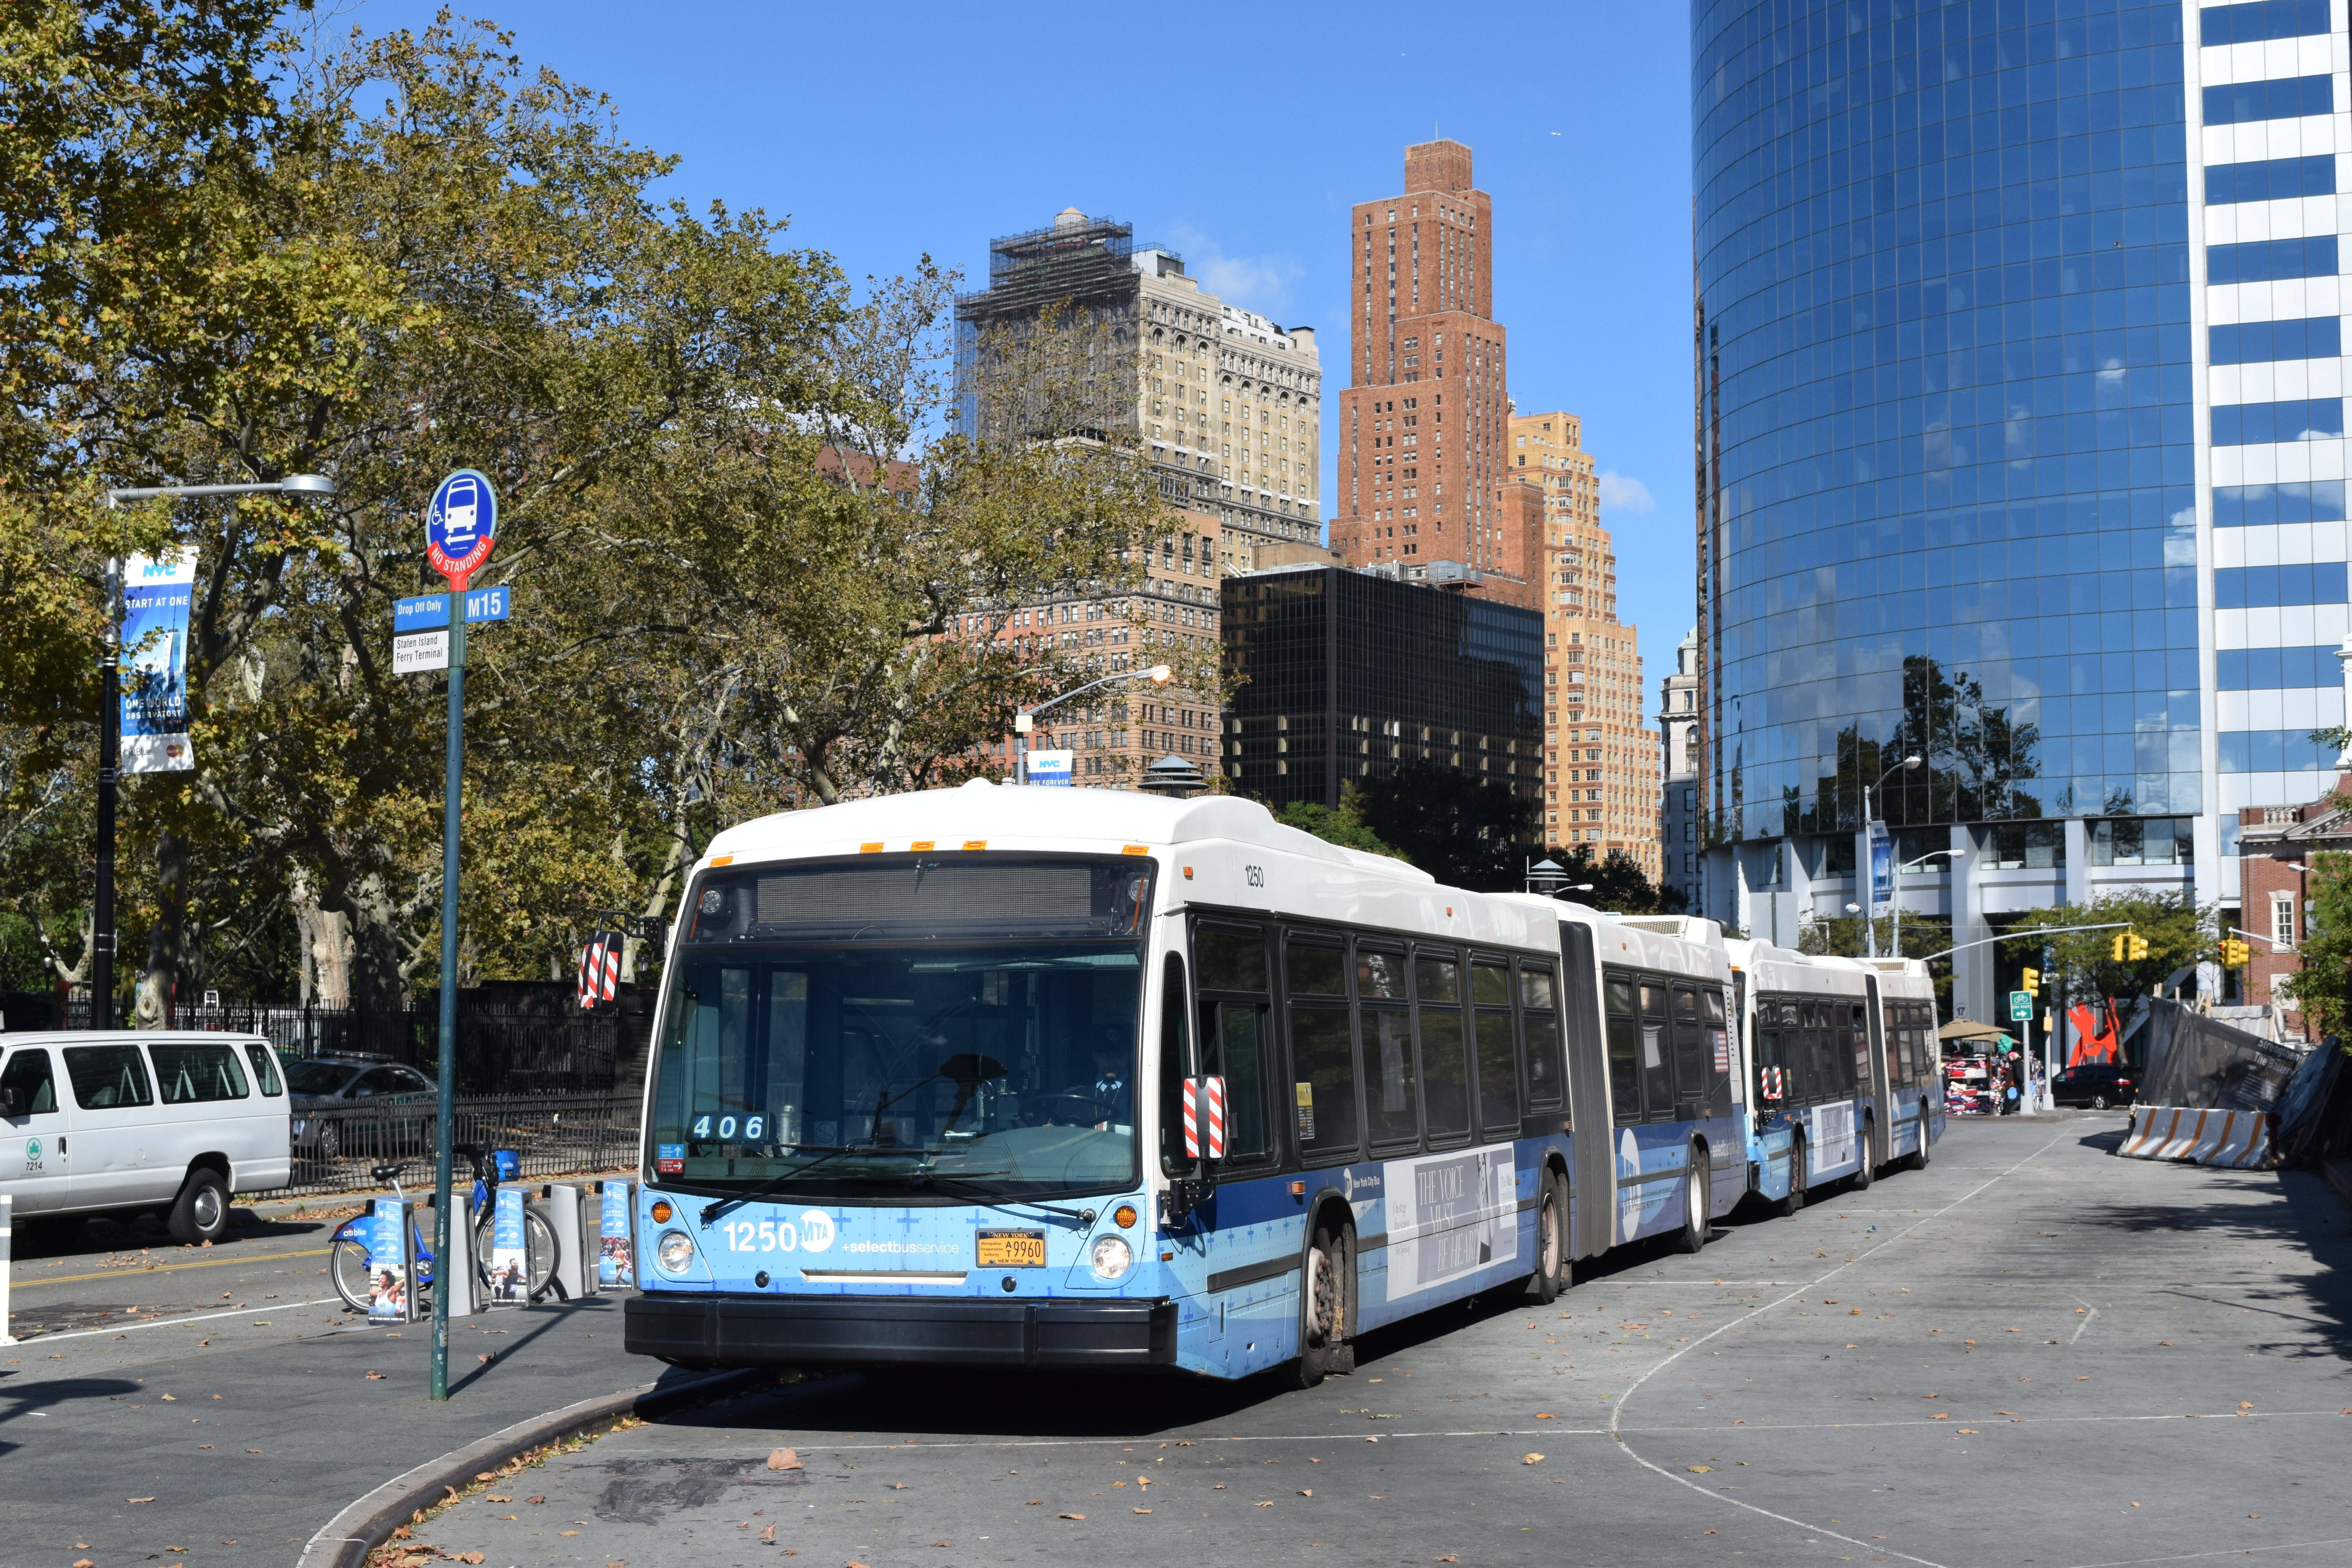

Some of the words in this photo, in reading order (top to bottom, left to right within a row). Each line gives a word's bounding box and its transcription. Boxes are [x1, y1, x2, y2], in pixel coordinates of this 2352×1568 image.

[432, 547, 443, 564] NO
[443, 541, 486, 573] STANDING
[143, 564, 176, 577] NYC
[125, 599, 153, 609] START
[156, 597, 167, 607] AT
[170, 596, 188, 606] ONE
[398, 604, 413, 616] Drop
[415, 602, 425, 613] Off
[426, 600, 441, 612] Only
[468, 592, 501, 617] M15
[397, 639, 416, 649] Staten
[419, 635, 437, 646] Island
[397, 653, 413, 662] Ferry
[415, 648, 442, 660] Terminal
[126, 699, 144, 709] ONE
[146, 697, 181, 707] WORLD
[128, 748, 151, 758] jetBlue
[1245, 864, 1264, 888] 1250
[1956, 1007, 1965, 1016] 17
[2253, 1052, 2267, 1066] The
[2267, 1058, 2294, 1079] Battery
[26, 1161, 42, 1171] 7214
[1418, 1171, 1437, 1205] THE
[1439, 1166, 1464, 1201] VOICE
[1393, 1201, 1398, 1214] On
[1430, 1202, 1455, 1238] MUST
[723, 1221, 797, 1252] 1250
[1014, 1241, 1040, 1258] 9960
[1437, 1238, 1448, 1271] BE
